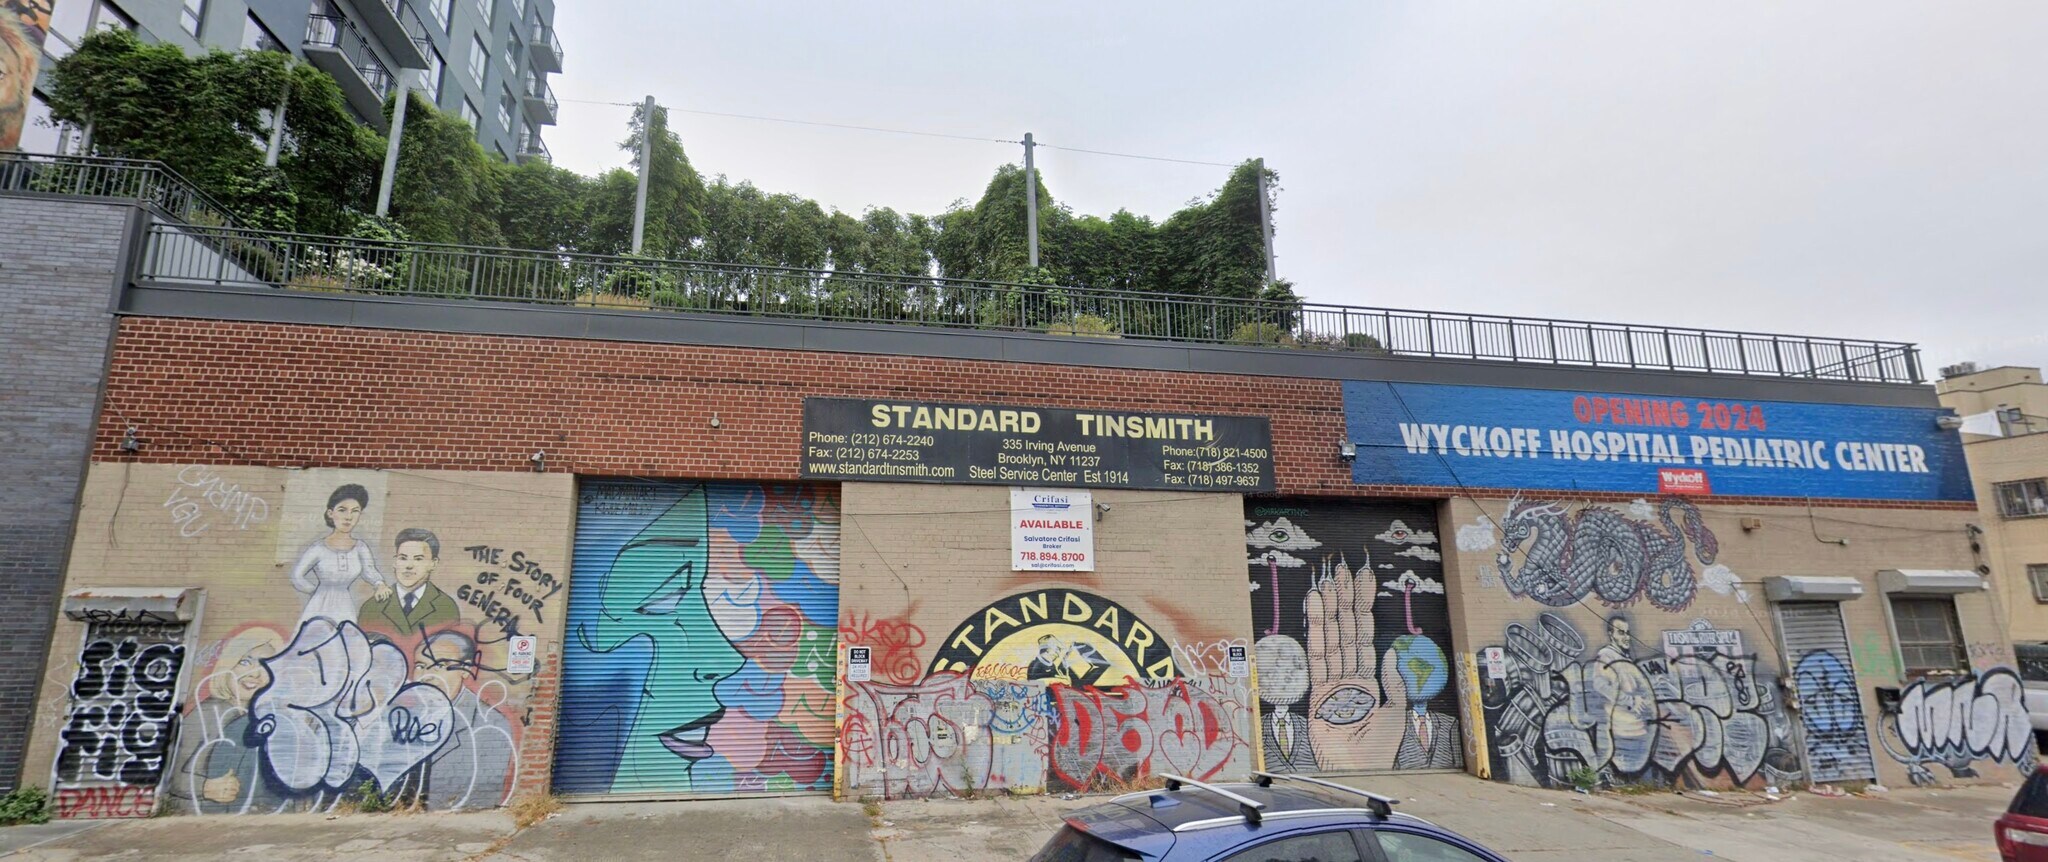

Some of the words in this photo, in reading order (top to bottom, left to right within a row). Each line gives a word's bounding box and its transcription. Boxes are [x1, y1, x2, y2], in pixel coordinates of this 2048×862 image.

[1573, 396, 1690, 428] OPENING
[1697, 402, 1766, 431] 2024
[872, 404, 1041, 434] STANDARD
[1076, 414, 1214, 440] TINSMITH
[809, 432, 848, 444] Phone:
[851, 433, 880, 447] (212)
[882, 434, 934, 447] 674-2240
[1002, 439, 1022, 450] 335
[1025, 440, 1054, 453] Irving
[1057, 442, 1096, 453] Avenue
[808, 447, 832, 458] Fax:
[836, 448, 865, 461] (212)
[868, 449, 919, 461] 674-2253
[1223, 447, 1267, 459] 821-4500
[1399, 422, 1542, 458] WYCKOFF
[1549, 429, 1686, 464] HOSPITAL
[1690, 434, 1830, 470] PEDIATRIC
[1834, 441, 1930, 473] CENTER
[998, 453, 1047, 466] Brooklyn,
[1050, 455, 1066, 466] NY
[1070, 456, 1100, 466] 11237
[1164, 460, 1184, 471] Fax:
[1187, 461, 1212, 473] (718)
[1215, 462, 1259, 473] 386-1352
[809, 461, 955, 477] www.standardtinsmith.com
[969, 466, 996, 479] Steel
[1000, 467, 1038, 481] Service
[1042, 469, 1077, 482] Center
[1084, 470, 1101, 483] Est
[1105, 471, 1128, 484] 1914
[1164, 474, 1185, 484] Fax:
[1188, 475, 1214, 487] (718)
[1215, 476, 1260, 486] 497-9637
[1661, 472, 1703, 484] Wyckoff
[1034, 495, 1068, 503] Crifasi
[1020, 520, 1083, 529] AVAILABLE
[464, 545, 504, 565] THE
[508, 551, 562, 600] STORY
[477, 572, 499, 585] OF
[504, 578, 543, 624] FOUR
